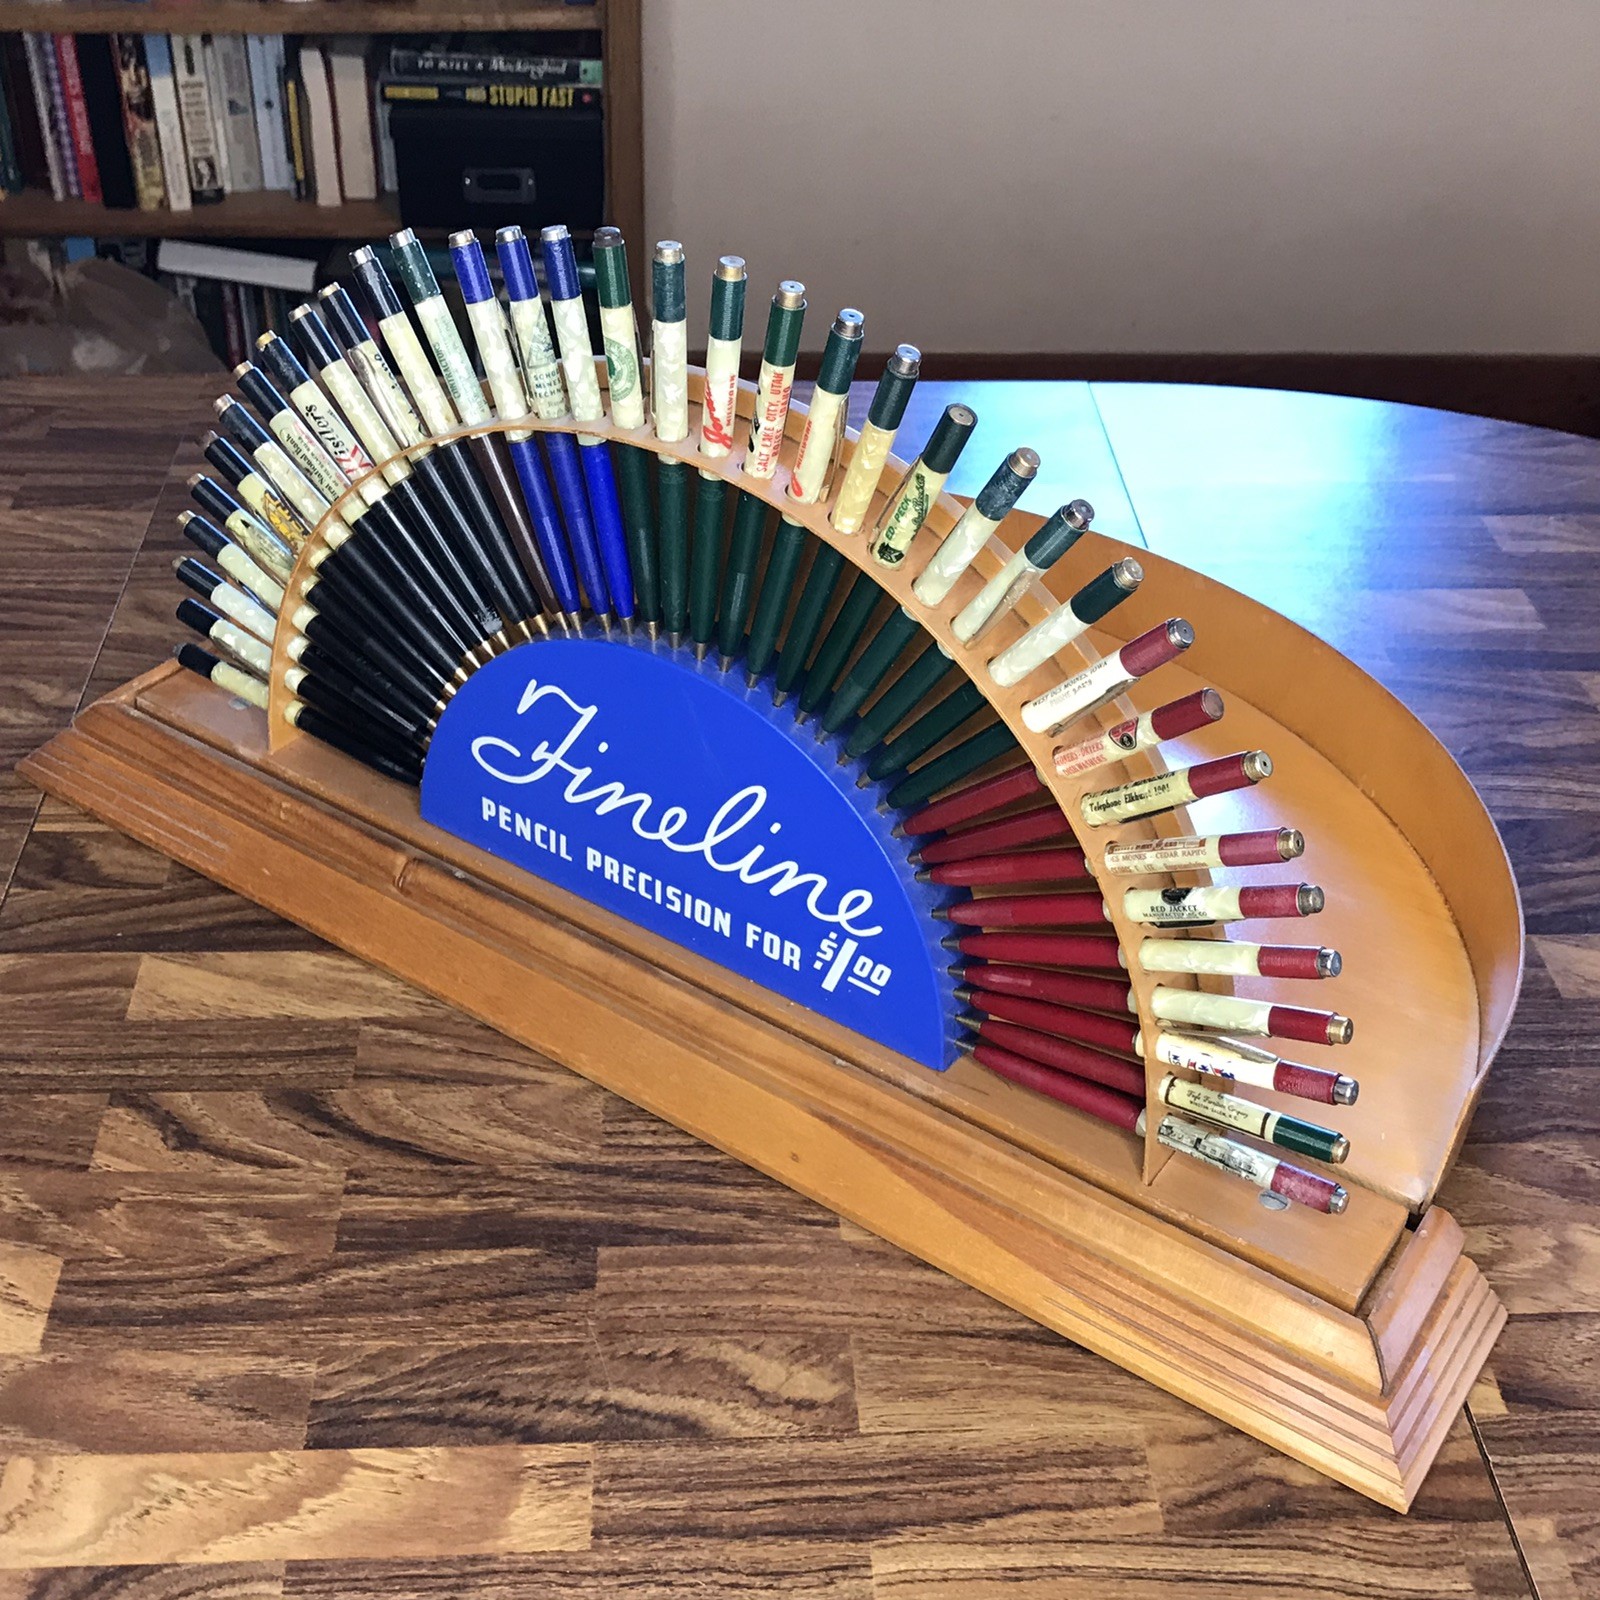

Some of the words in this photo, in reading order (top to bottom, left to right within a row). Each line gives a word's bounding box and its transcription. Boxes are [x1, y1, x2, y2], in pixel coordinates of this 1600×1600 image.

[490, 84, 538, 106] STUPID
[542, 86, 574, 107] FAST
[770, 372, 784, 395] UTAH
[765, 400, 780, 421] CITY,
[283, 433, 302, 454] Bank
[304, 404, 376, 474] Kistler's
[760, 426, 774, 447] LAKE
[299, 453, 326, 485] National
[756, 451, 769, 472] SALT
[884, 523, 896, 540] ED.
[893, 493, 912, 522] PECK
[470, 677, 884, 938] Fineline
[1088, 799, 1121, 811] Telephone
[1155, 851, 1178, 859] CEDAR
[481, 796, 573, 862] PENCIL
[586, 846, 731, 938] PRECISION
[744, 922, 802, 972] FOR
